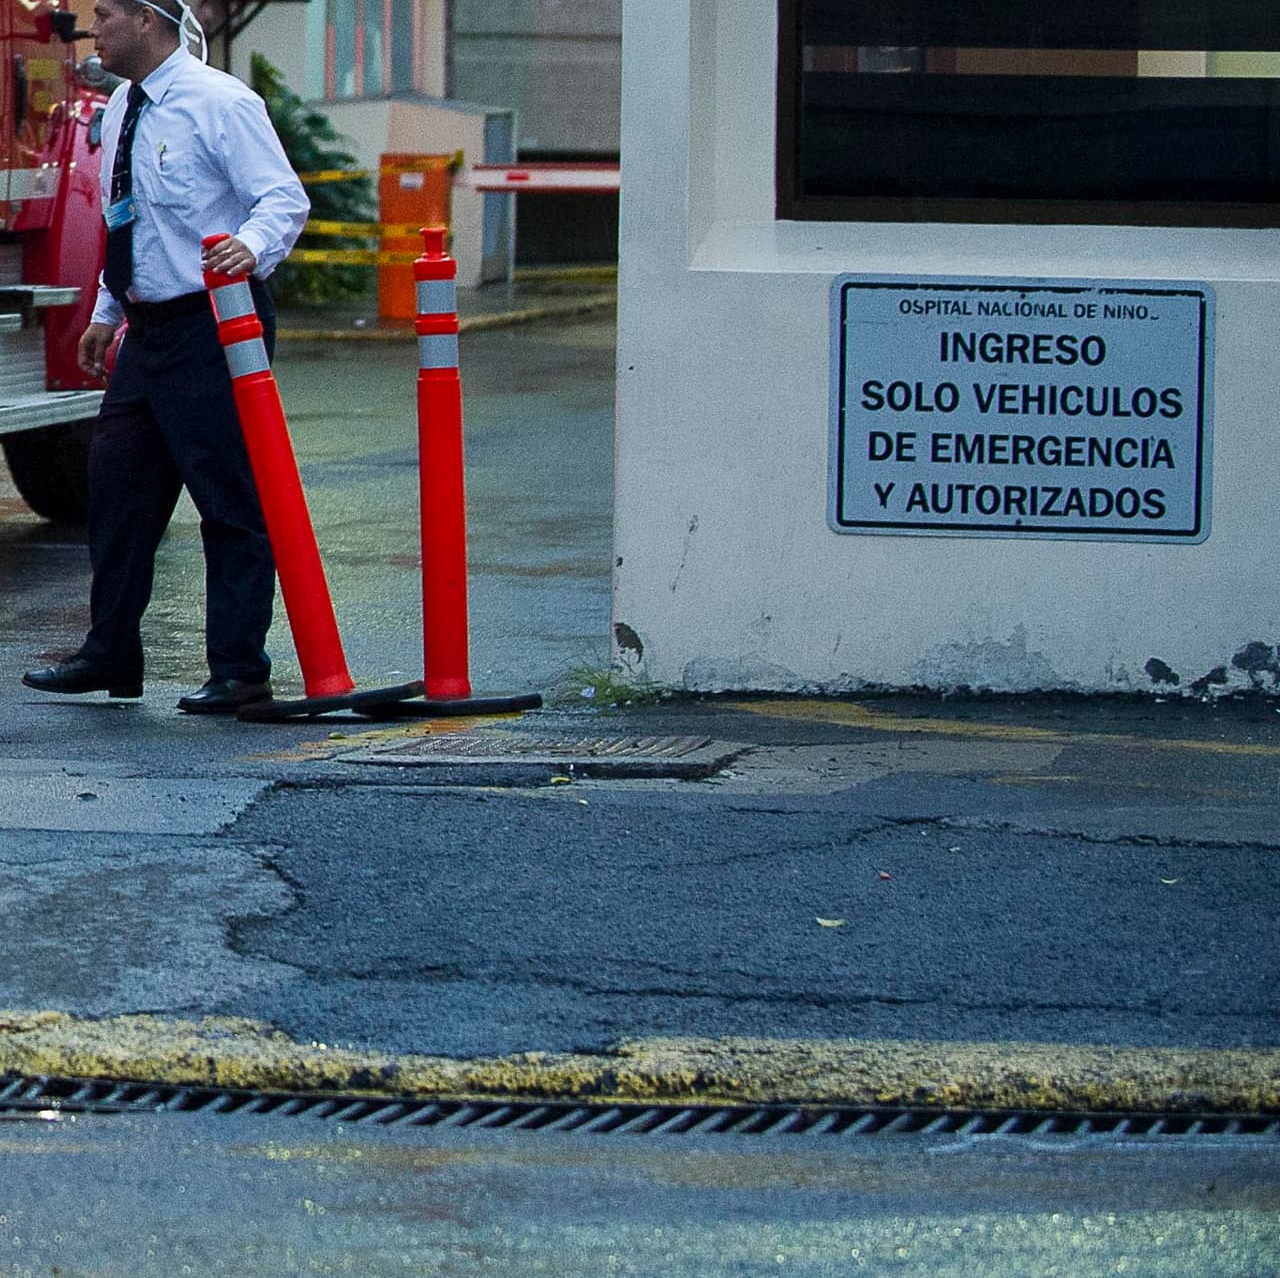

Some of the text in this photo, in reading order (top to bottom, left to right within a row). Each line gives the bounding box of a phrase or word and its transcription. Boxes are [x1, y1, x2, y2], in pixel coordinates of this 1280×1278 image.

[977, 301, 1068, 317] NACIONAL
[1073, 304, 1098, 318] DE
[1103, 304, 1159, 320] NINO
[940, 332, 1106, 366] INGRESO
[861, 380, 1183, 419] SOLO VEHICULOS
[868, 431, 1176, 469] DE EMERGENCIA
[873, 482, 1167, 519] Y AUTORIZADOS
